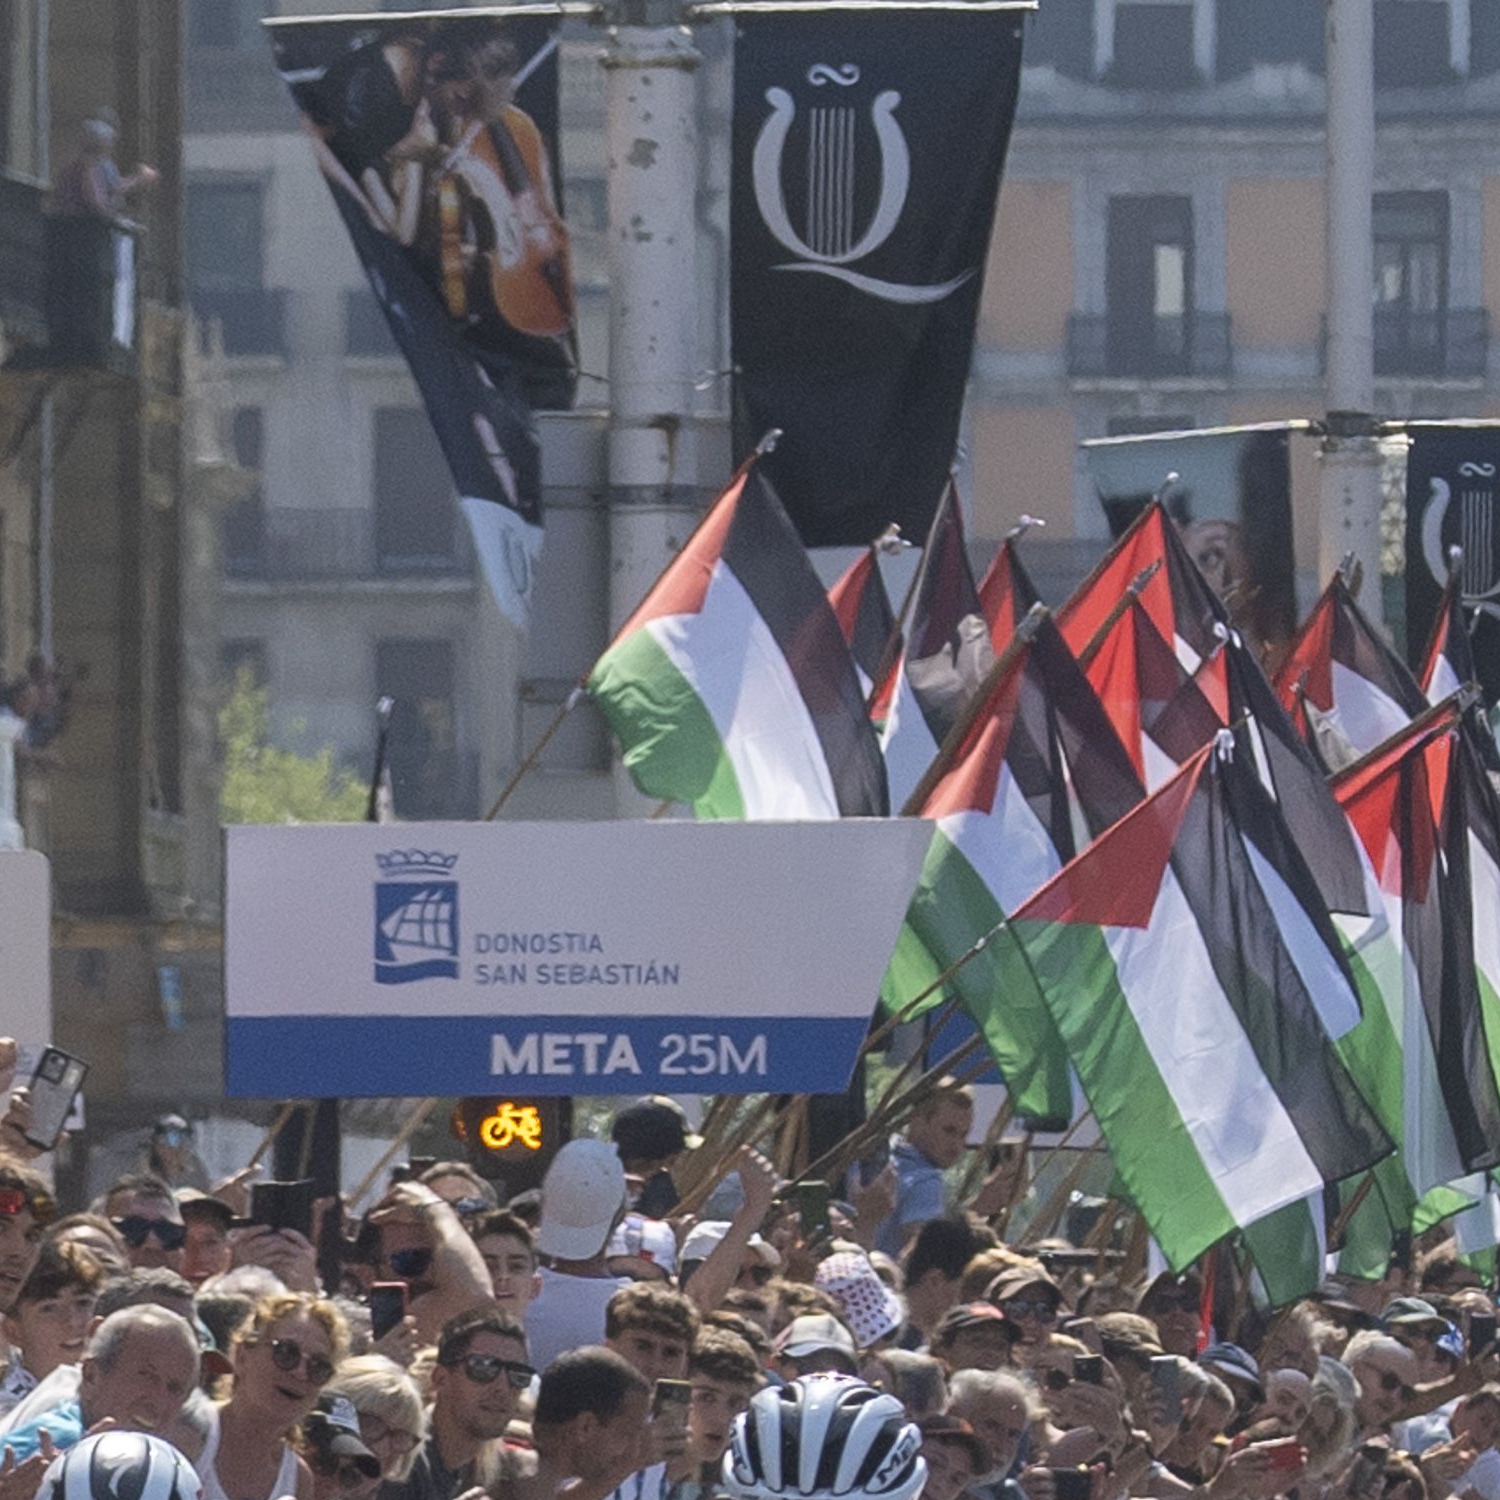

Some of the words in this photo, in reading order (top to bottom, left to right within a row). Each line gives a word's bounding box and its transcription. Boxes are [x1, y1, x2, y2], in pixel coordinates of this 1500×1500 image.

[475, 933, 604, 954] DONOSTIA
[476, 964, 527, 985] SAN
[536, 960, 680, 985] SEBASTIÁN
[490, 1033, 643, 1075] META
[658, 1033, 768, 1075] 25M
[876, 1432, 917, 1486] MET
